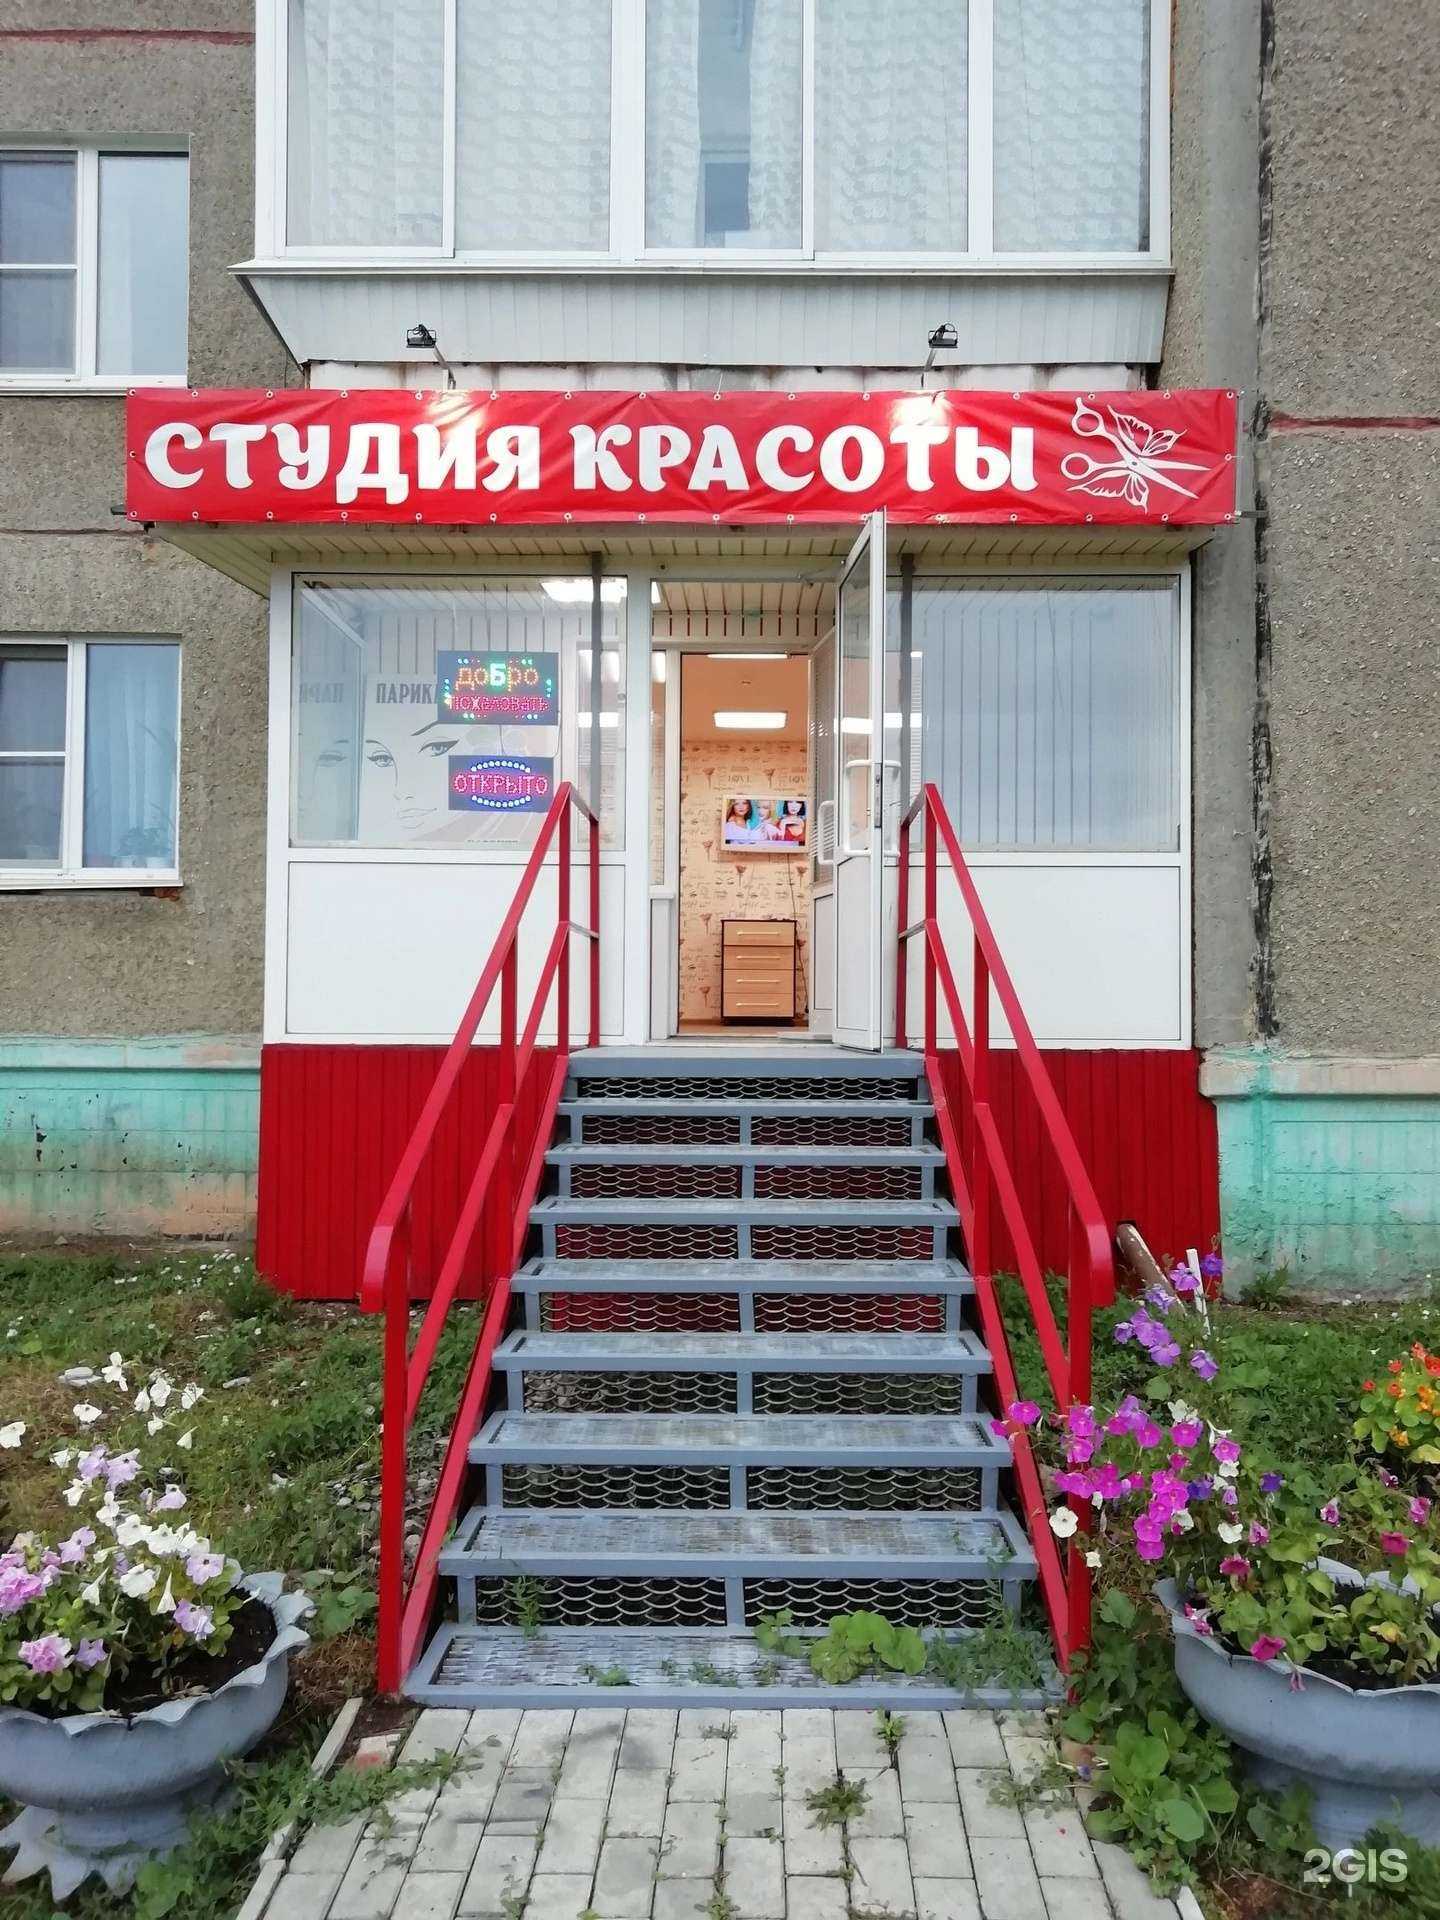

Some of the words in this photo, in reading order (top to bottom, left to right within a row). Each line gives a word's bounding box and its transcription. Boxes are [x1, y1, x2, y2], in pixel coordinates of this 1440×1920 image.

[144, 422, 541, 505] СТУДИЯ
[568, 424, 1039, 493] КРАСОТЫ
[376, 683, 438, 704] ПАРИК
[454, 774, 548, 795] ОТКРЫТО
